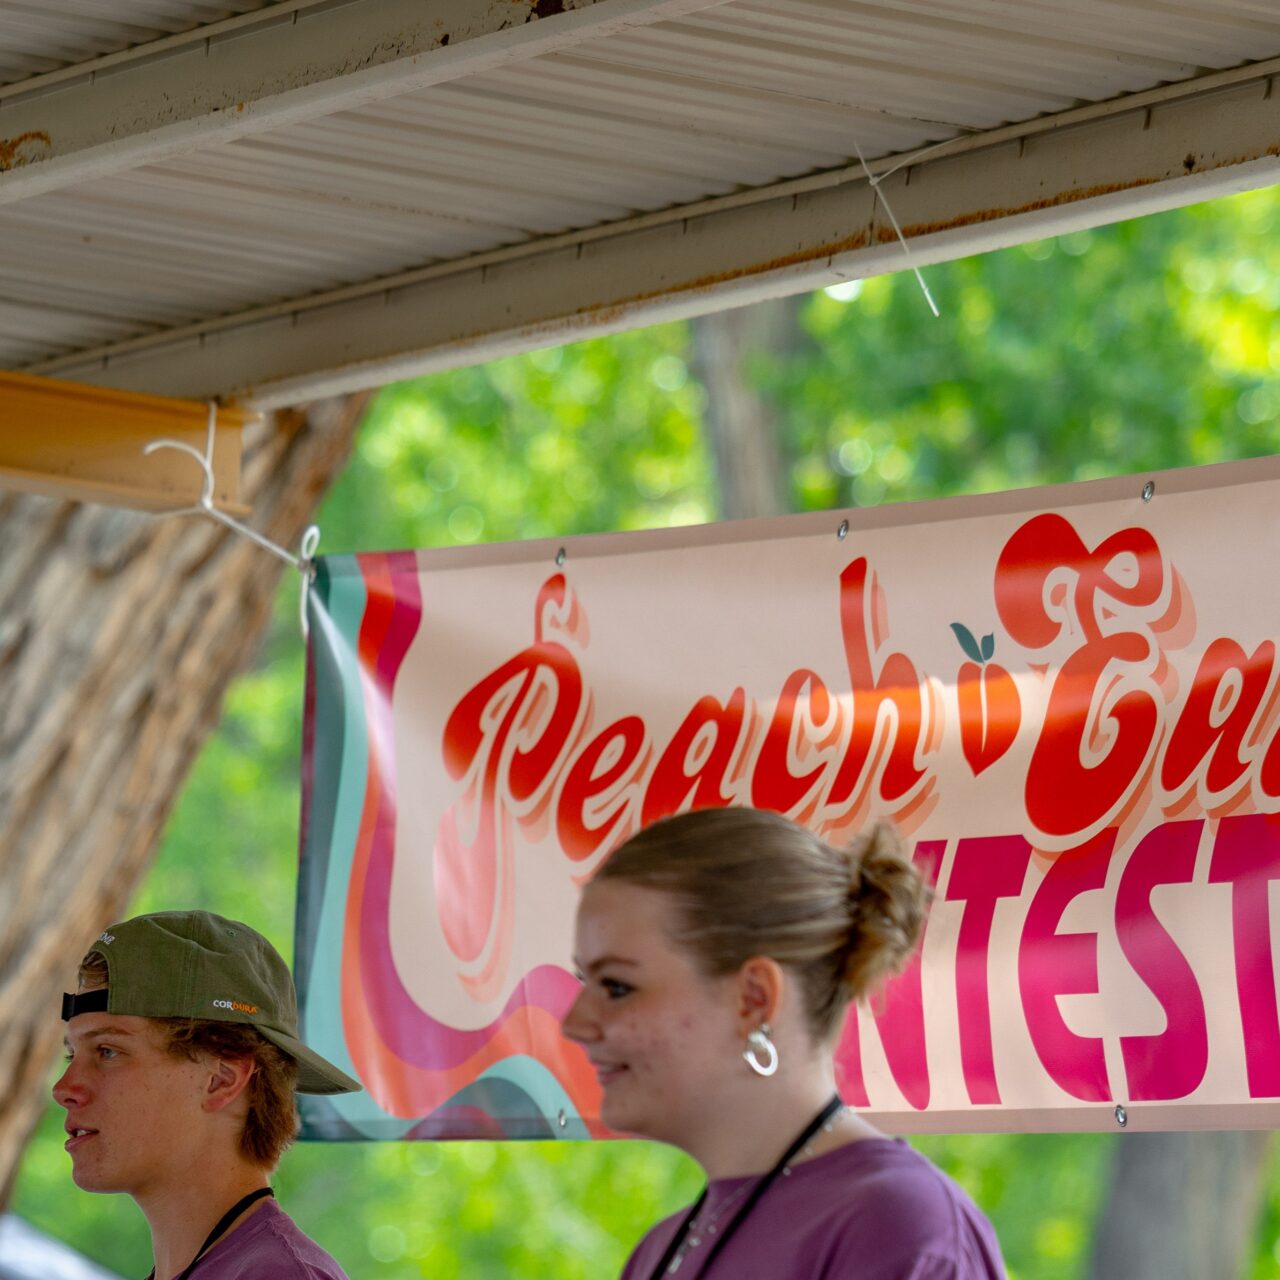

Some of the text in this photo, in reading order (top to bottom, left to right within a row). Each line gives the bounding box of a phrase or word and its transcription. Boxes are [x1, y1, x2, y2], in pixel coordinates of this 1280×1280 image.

[433, 557, 930, 963] Peach
[212, 999, 257, 1014] CORDURA
[834, 814, 1280, 1110] NTEST
